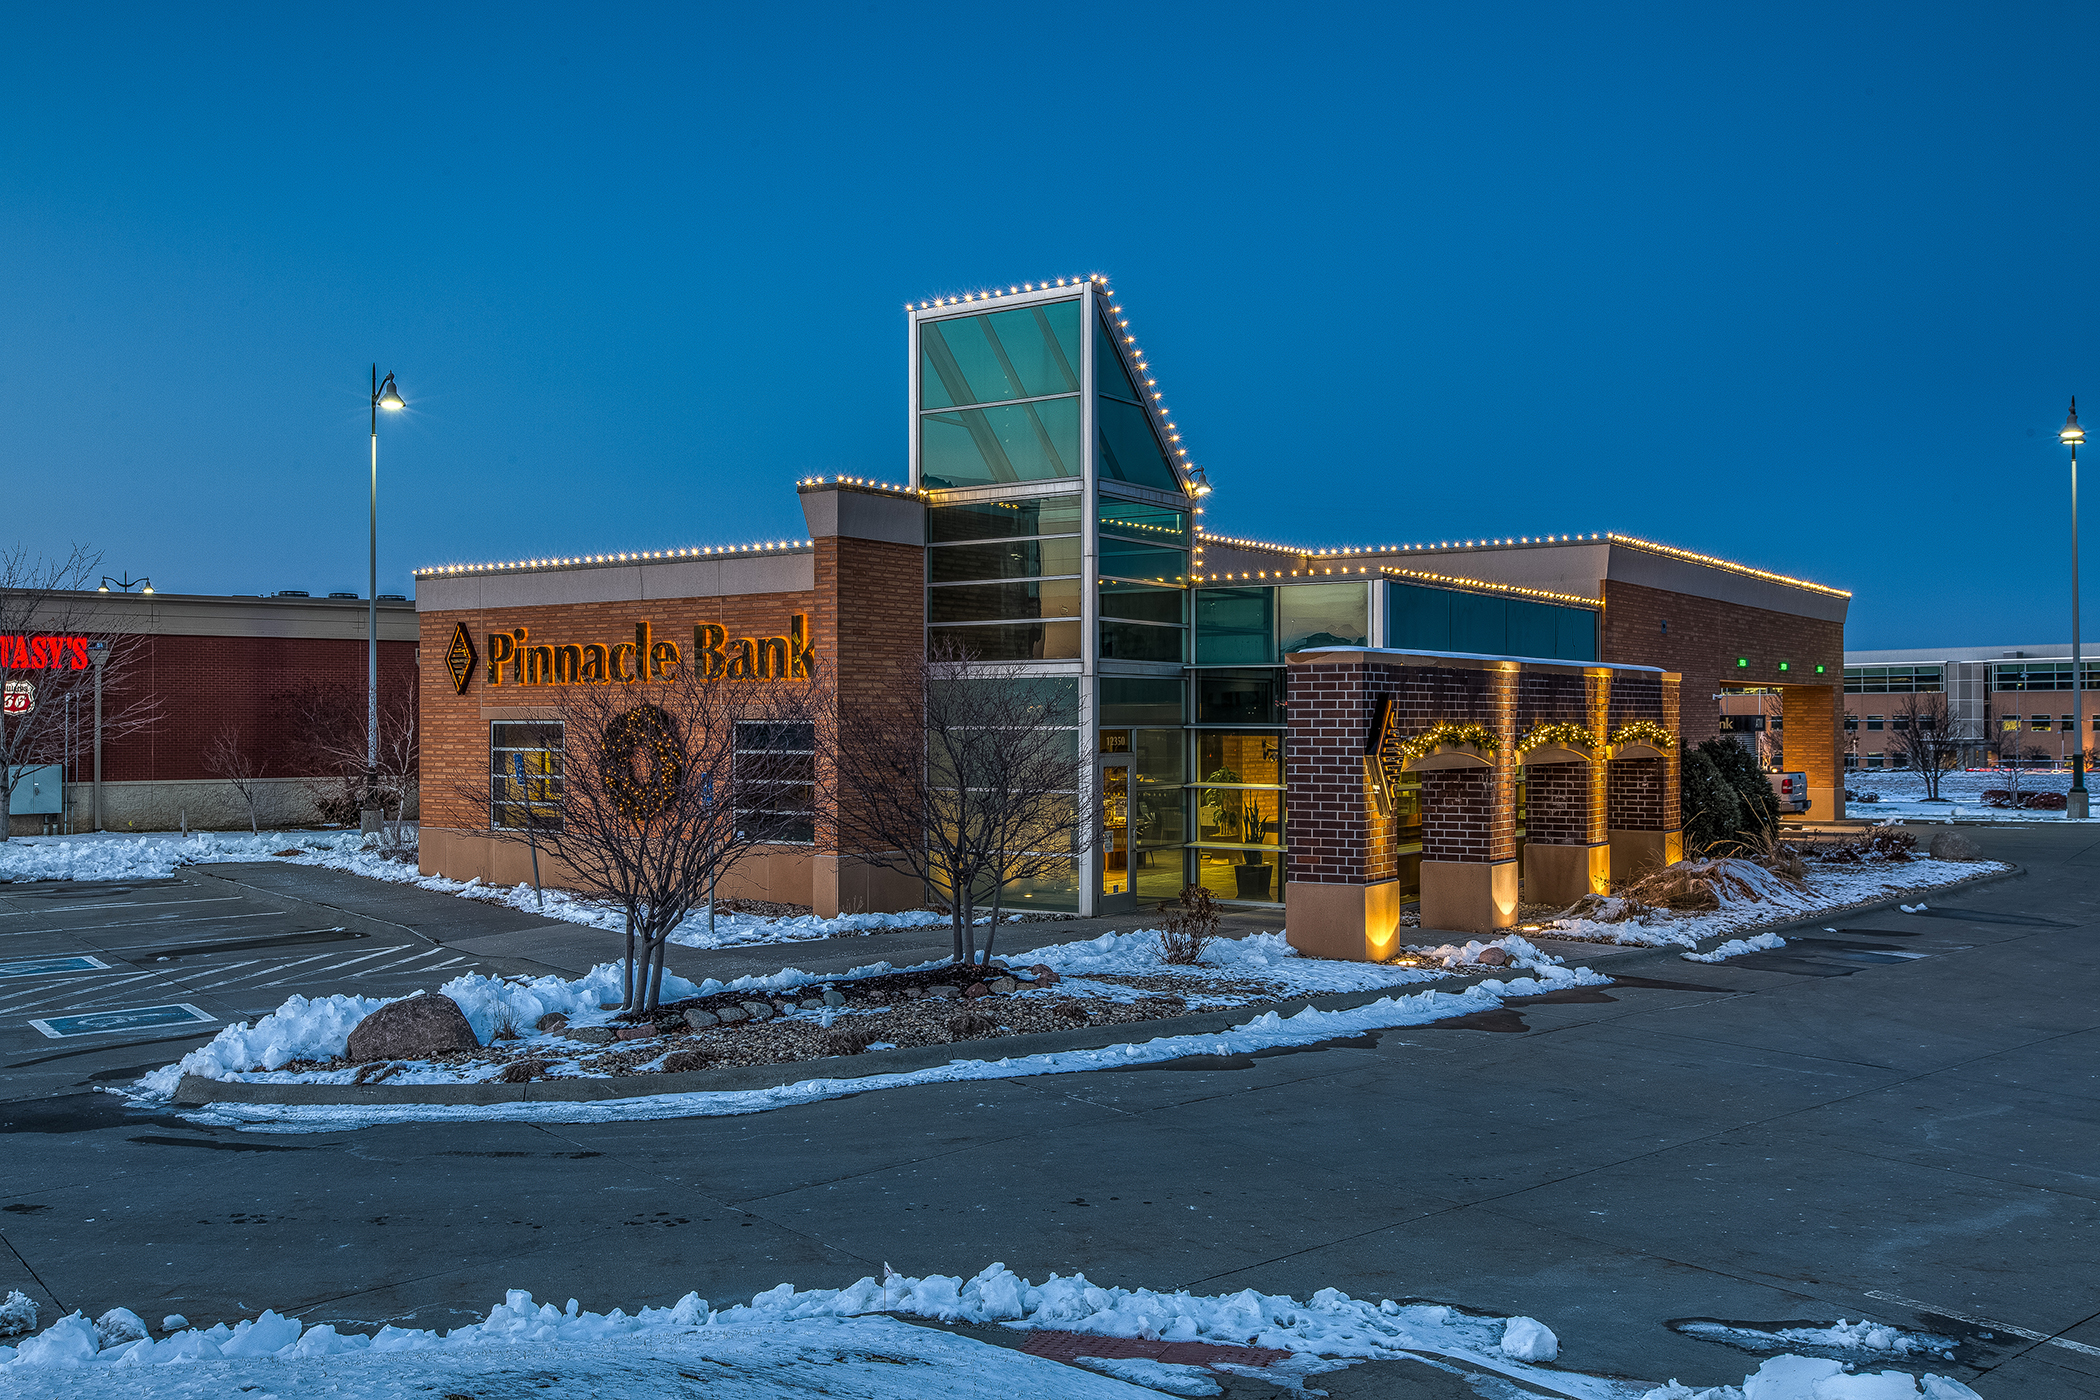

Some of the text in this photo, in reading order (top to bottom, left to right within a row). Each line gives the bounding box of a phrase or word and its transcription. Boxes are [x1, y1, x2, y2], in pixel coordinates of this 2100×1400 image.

[487, 613, 815, 685] Pinnacle Bank
[1106, 736, 1126, 746] 12350
